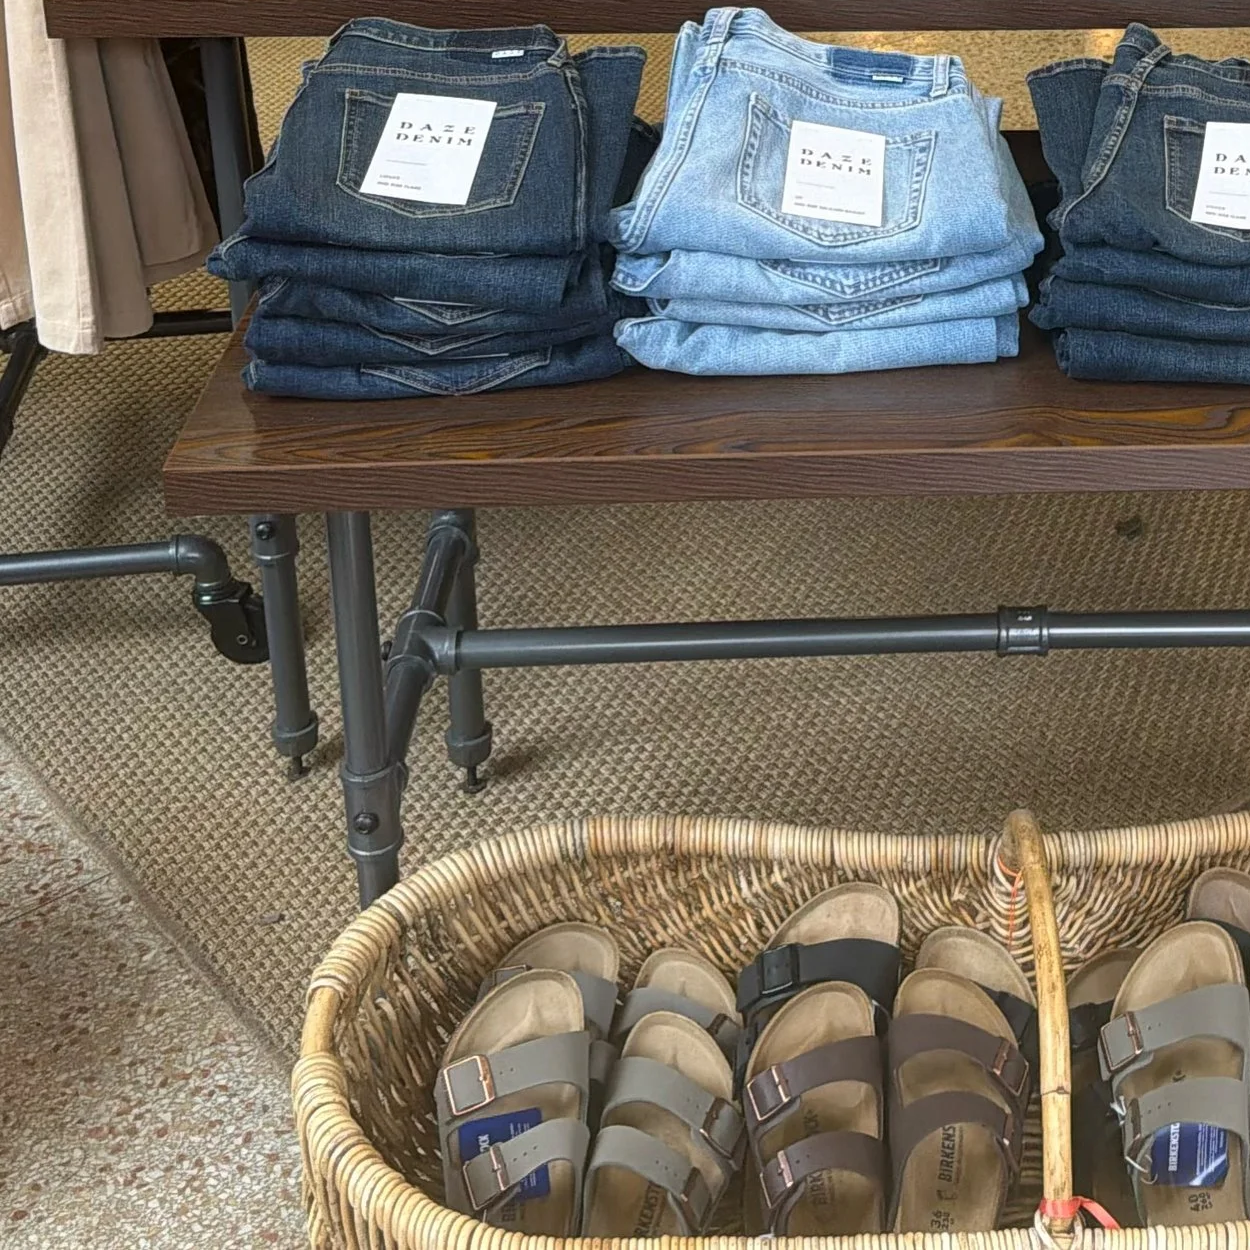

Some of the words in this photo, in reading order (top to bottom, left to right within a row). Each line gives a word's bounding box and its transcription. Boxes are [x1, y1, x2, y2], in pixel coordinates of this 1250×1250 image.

[399, 121, 476, 135] DAZE
[396, 133, 472, 146] DENIM
[801, 148, 872, 166] DAZE
[800, 158, 871, 176] DENIM
